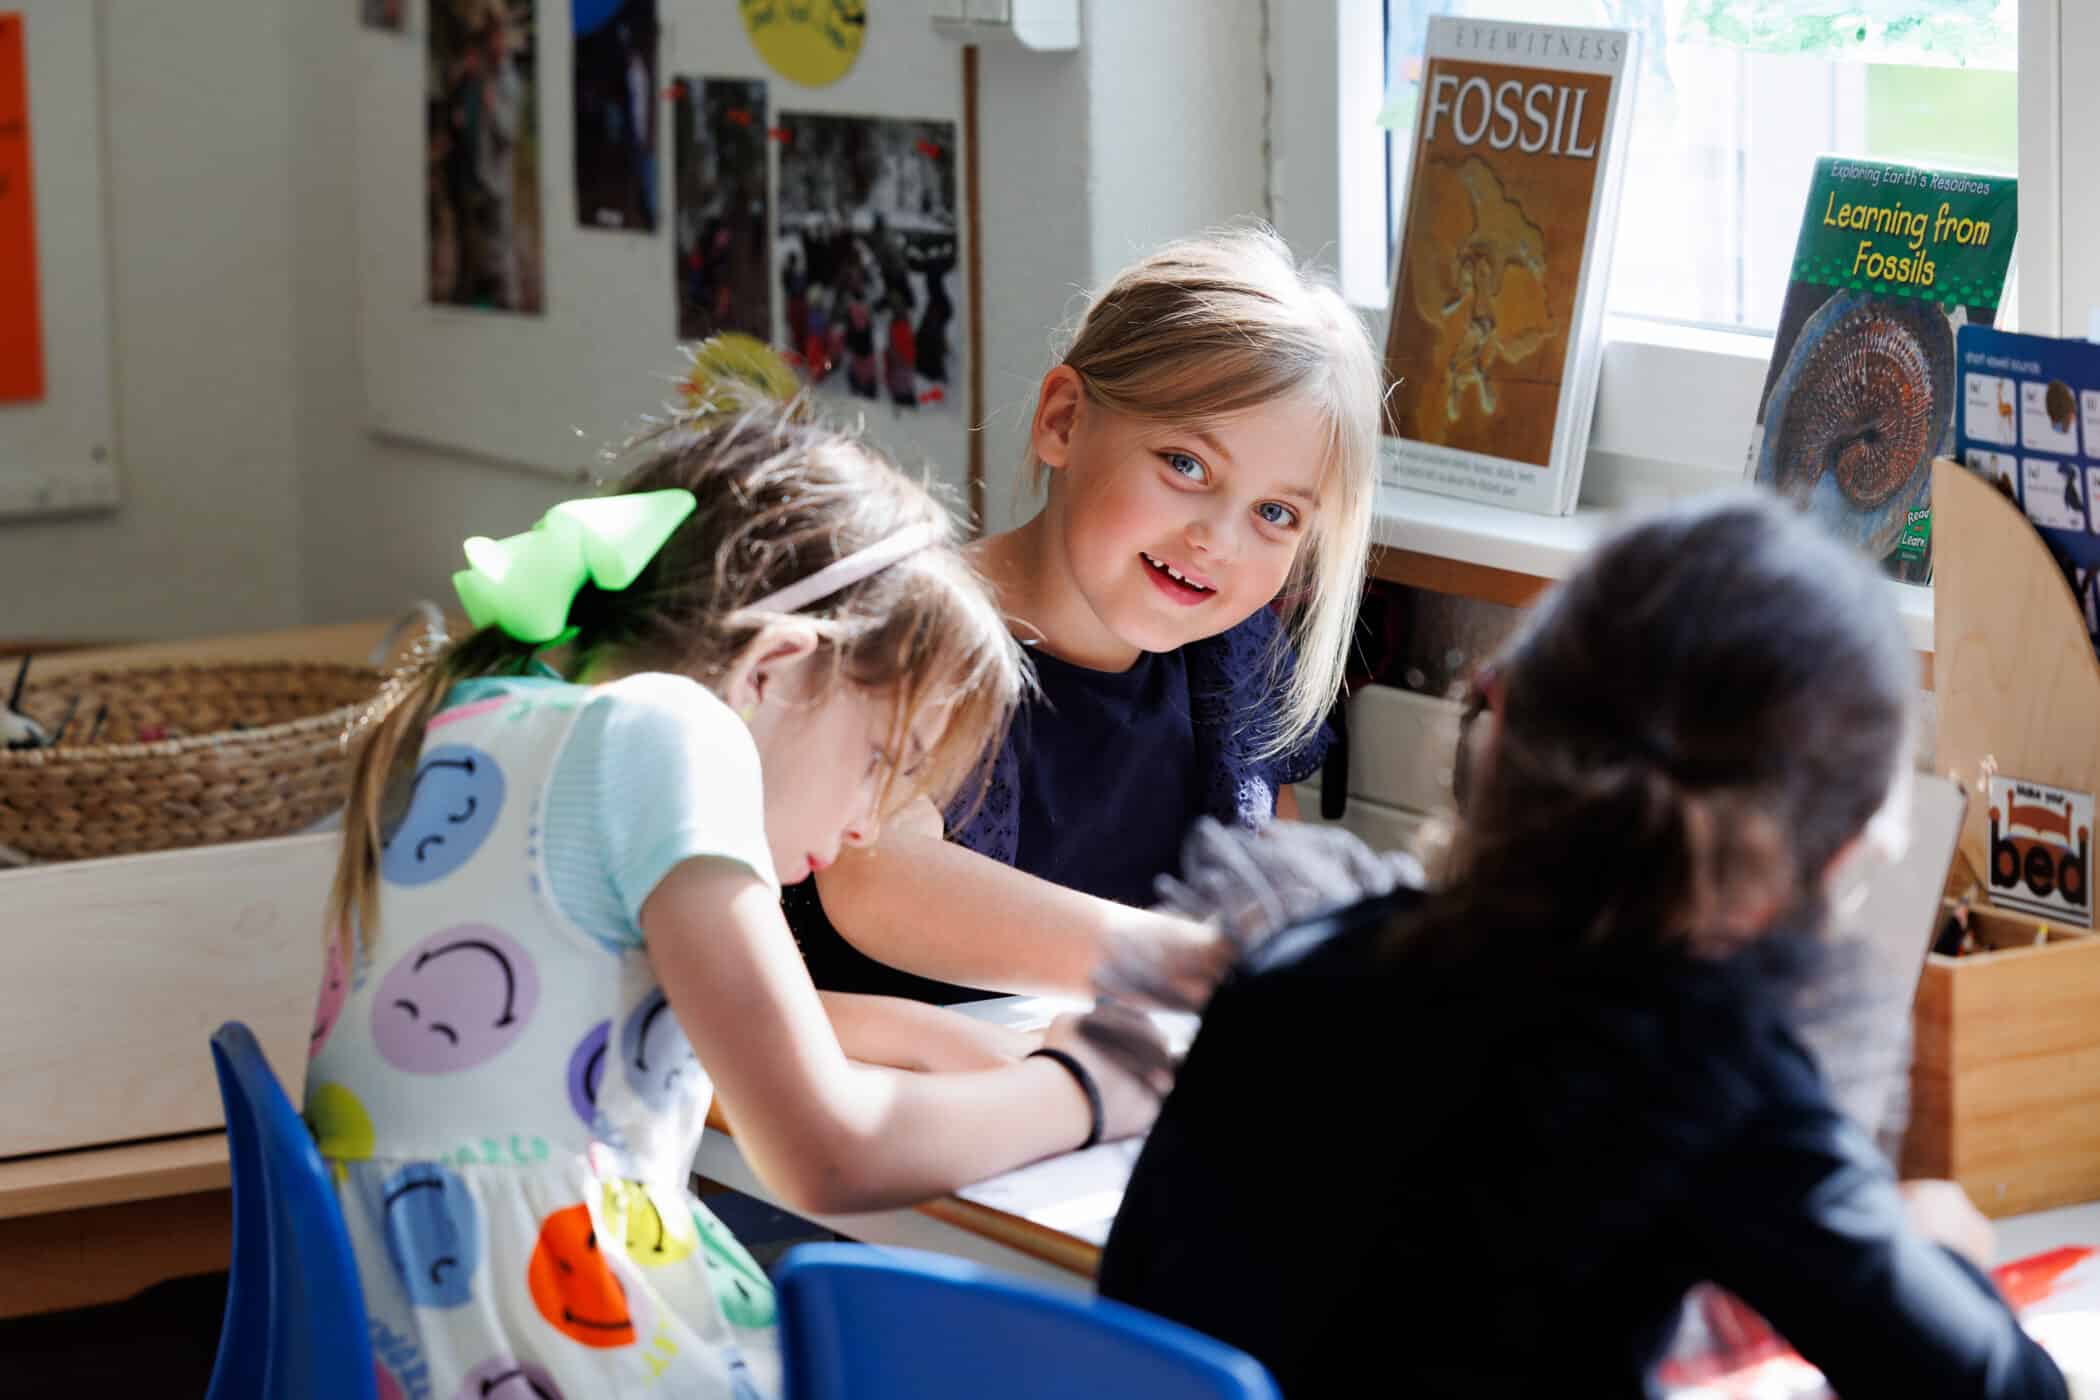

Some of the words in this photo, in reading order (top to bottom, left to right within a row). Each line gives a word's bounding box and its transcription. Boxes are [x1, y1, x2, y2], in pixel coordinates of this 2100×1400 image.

[1455, 25, 1621, 62] EYEWITNESS
[1424, 73, 1598, 158] FOSSIL
[1831, 160, 1880, 187] Exploring
[1883, 166, 1927, 188] Earth's
[1930, 174, 1990, 195] Resources
[1823, 191, 1929, 250] Learning
[1933, 202, 1991, 246] from
[1853, 240, 1936, 286] Fossils
[1990, 816, 2088, 907] bed
